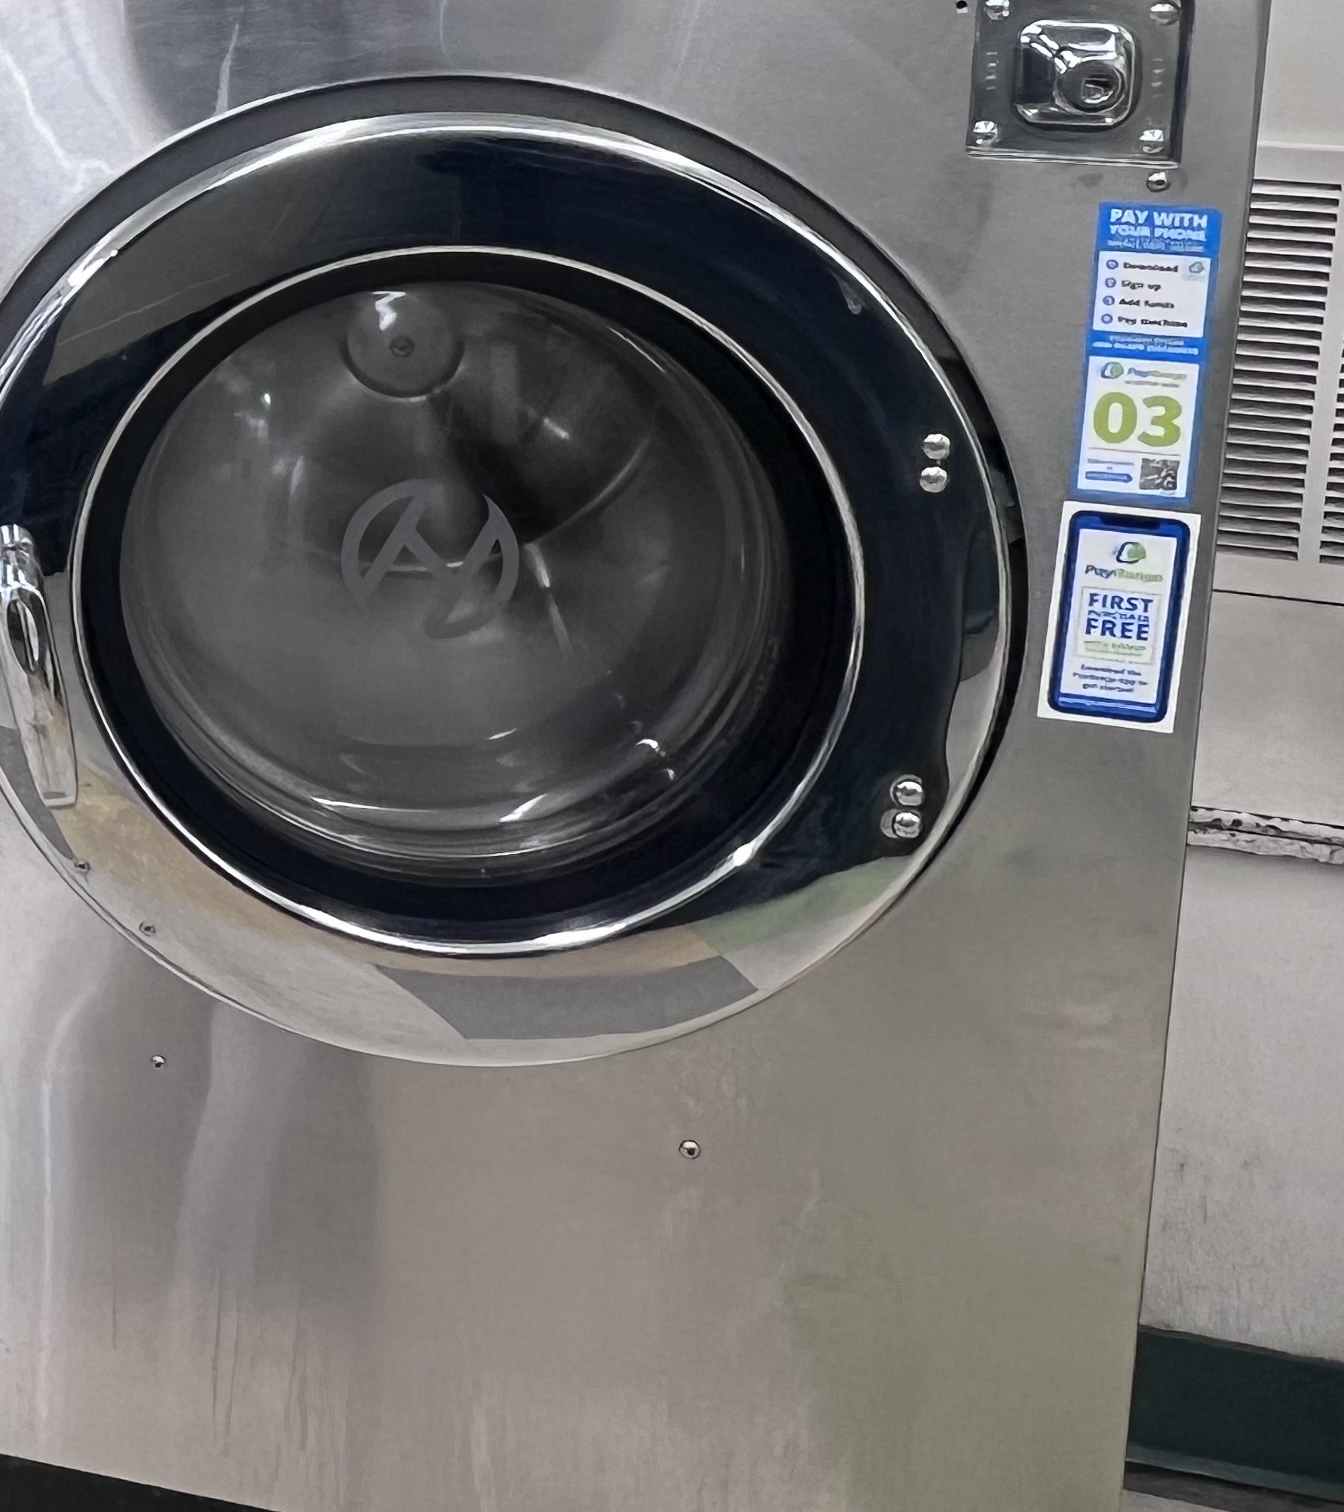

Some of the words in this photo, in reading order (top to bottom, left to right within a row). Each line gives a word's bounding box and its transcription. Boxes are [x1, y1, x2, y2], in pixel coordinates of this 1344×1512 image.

[1110, 208, 1149, 224] PAY
[1153, 211, 1208, 228] WITH
[1093, 391, 1183, 448] 03
[1088, 592, 1154, 613] FIRST
[1085, 618, 1150, 641] FREE
